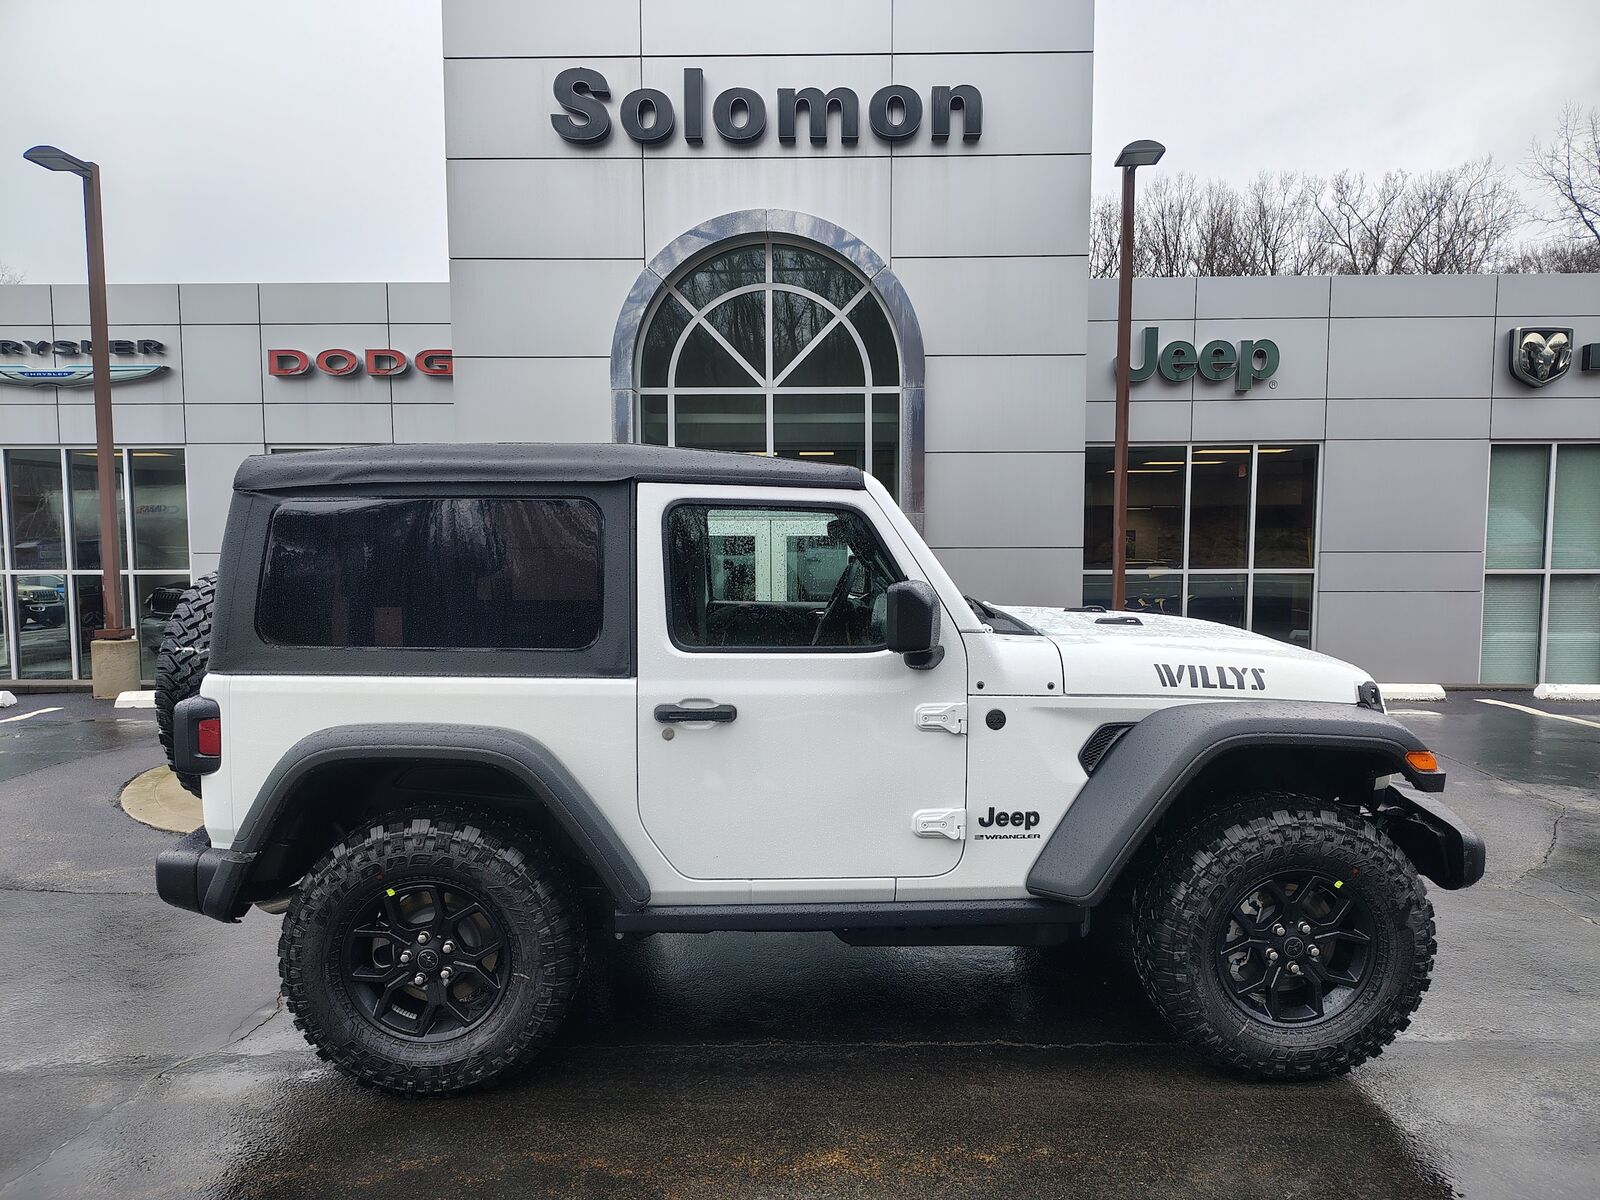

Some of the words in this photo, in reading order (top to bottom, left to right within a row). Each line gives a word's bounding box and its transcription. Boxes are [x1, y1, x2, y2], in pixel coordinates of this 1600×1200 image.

[550, 67, 984, 145] Solomon
[268, 349, 453, 376] DODG
[1128, 327, 1280, 391] Jeep
[1153, 663, 1265, 691] WILLYS
[978, 806, 1040, 831] Jeep
